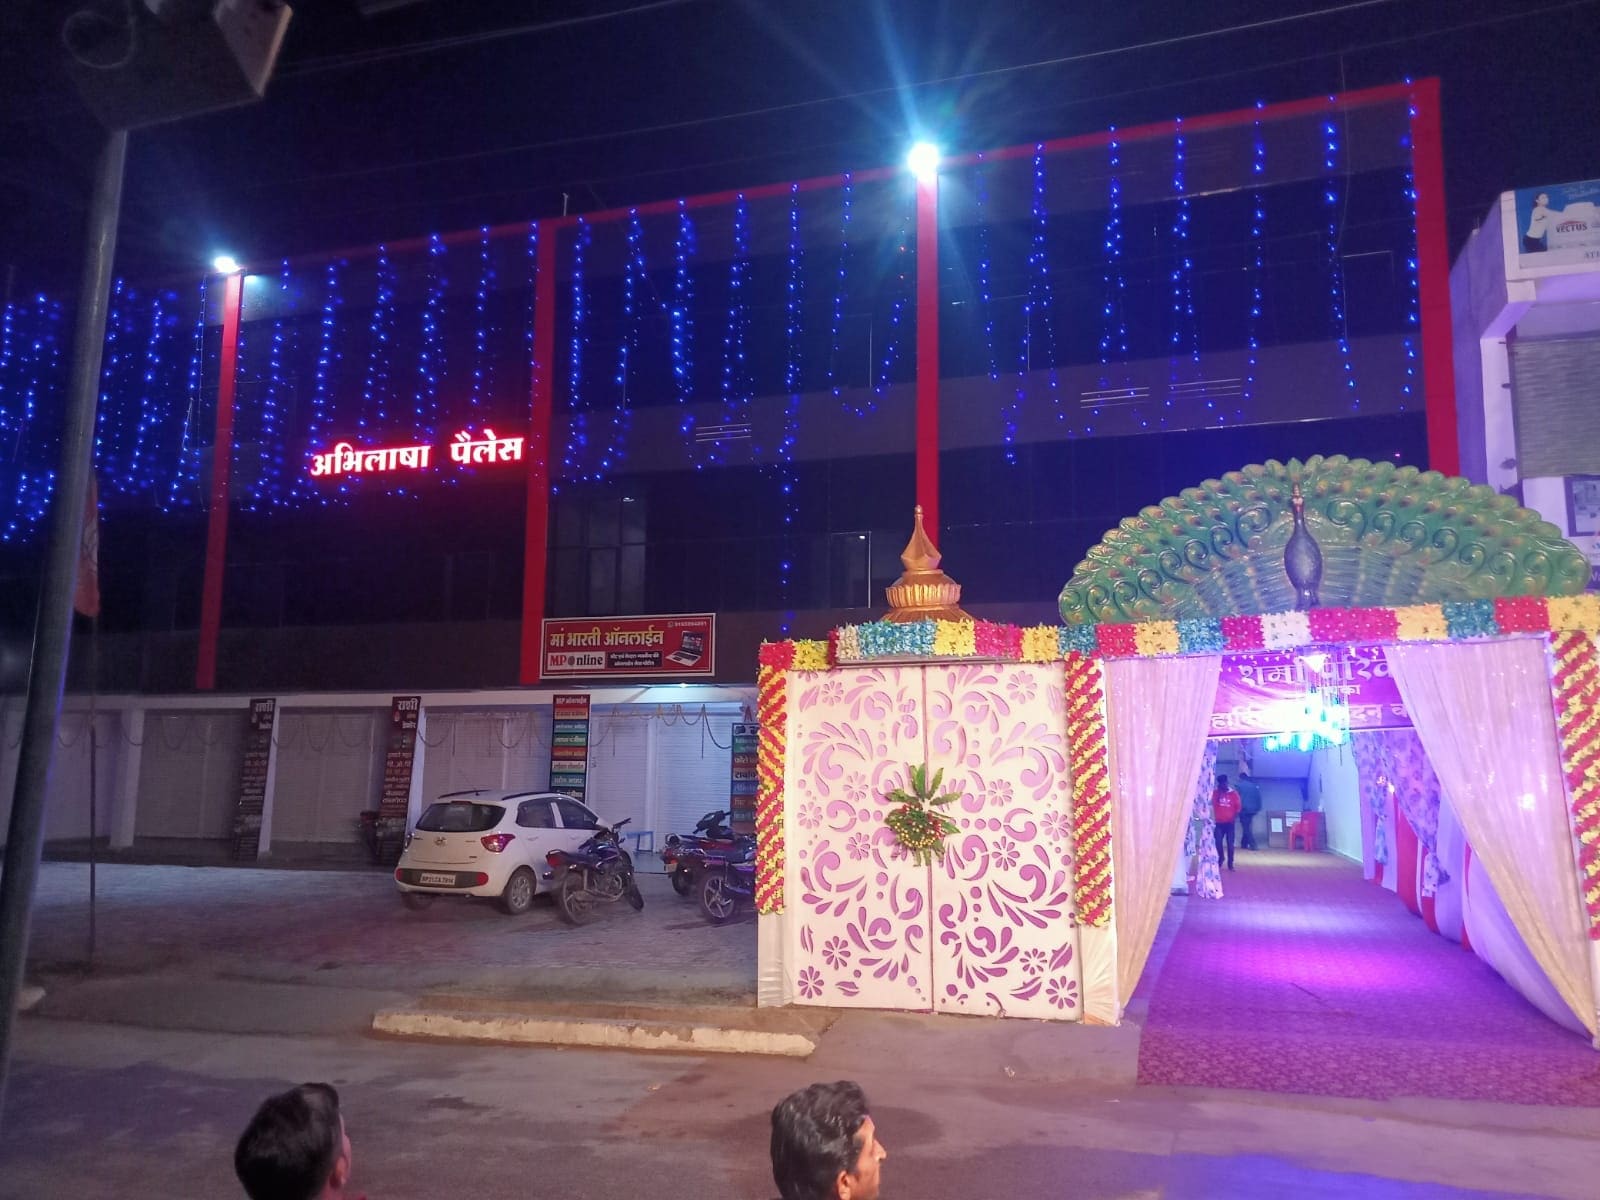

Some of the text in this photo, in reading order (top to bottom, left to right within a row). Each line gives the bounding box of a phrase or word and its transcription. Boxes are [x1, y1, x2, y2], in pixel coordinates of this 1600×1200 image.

[1556, 223, 1588, 233] VECTUS
[310, 429, 524, 476] अभिलाषा पैलेस
[550, 625, 664, 647] मां भारती ऑनलाईन
